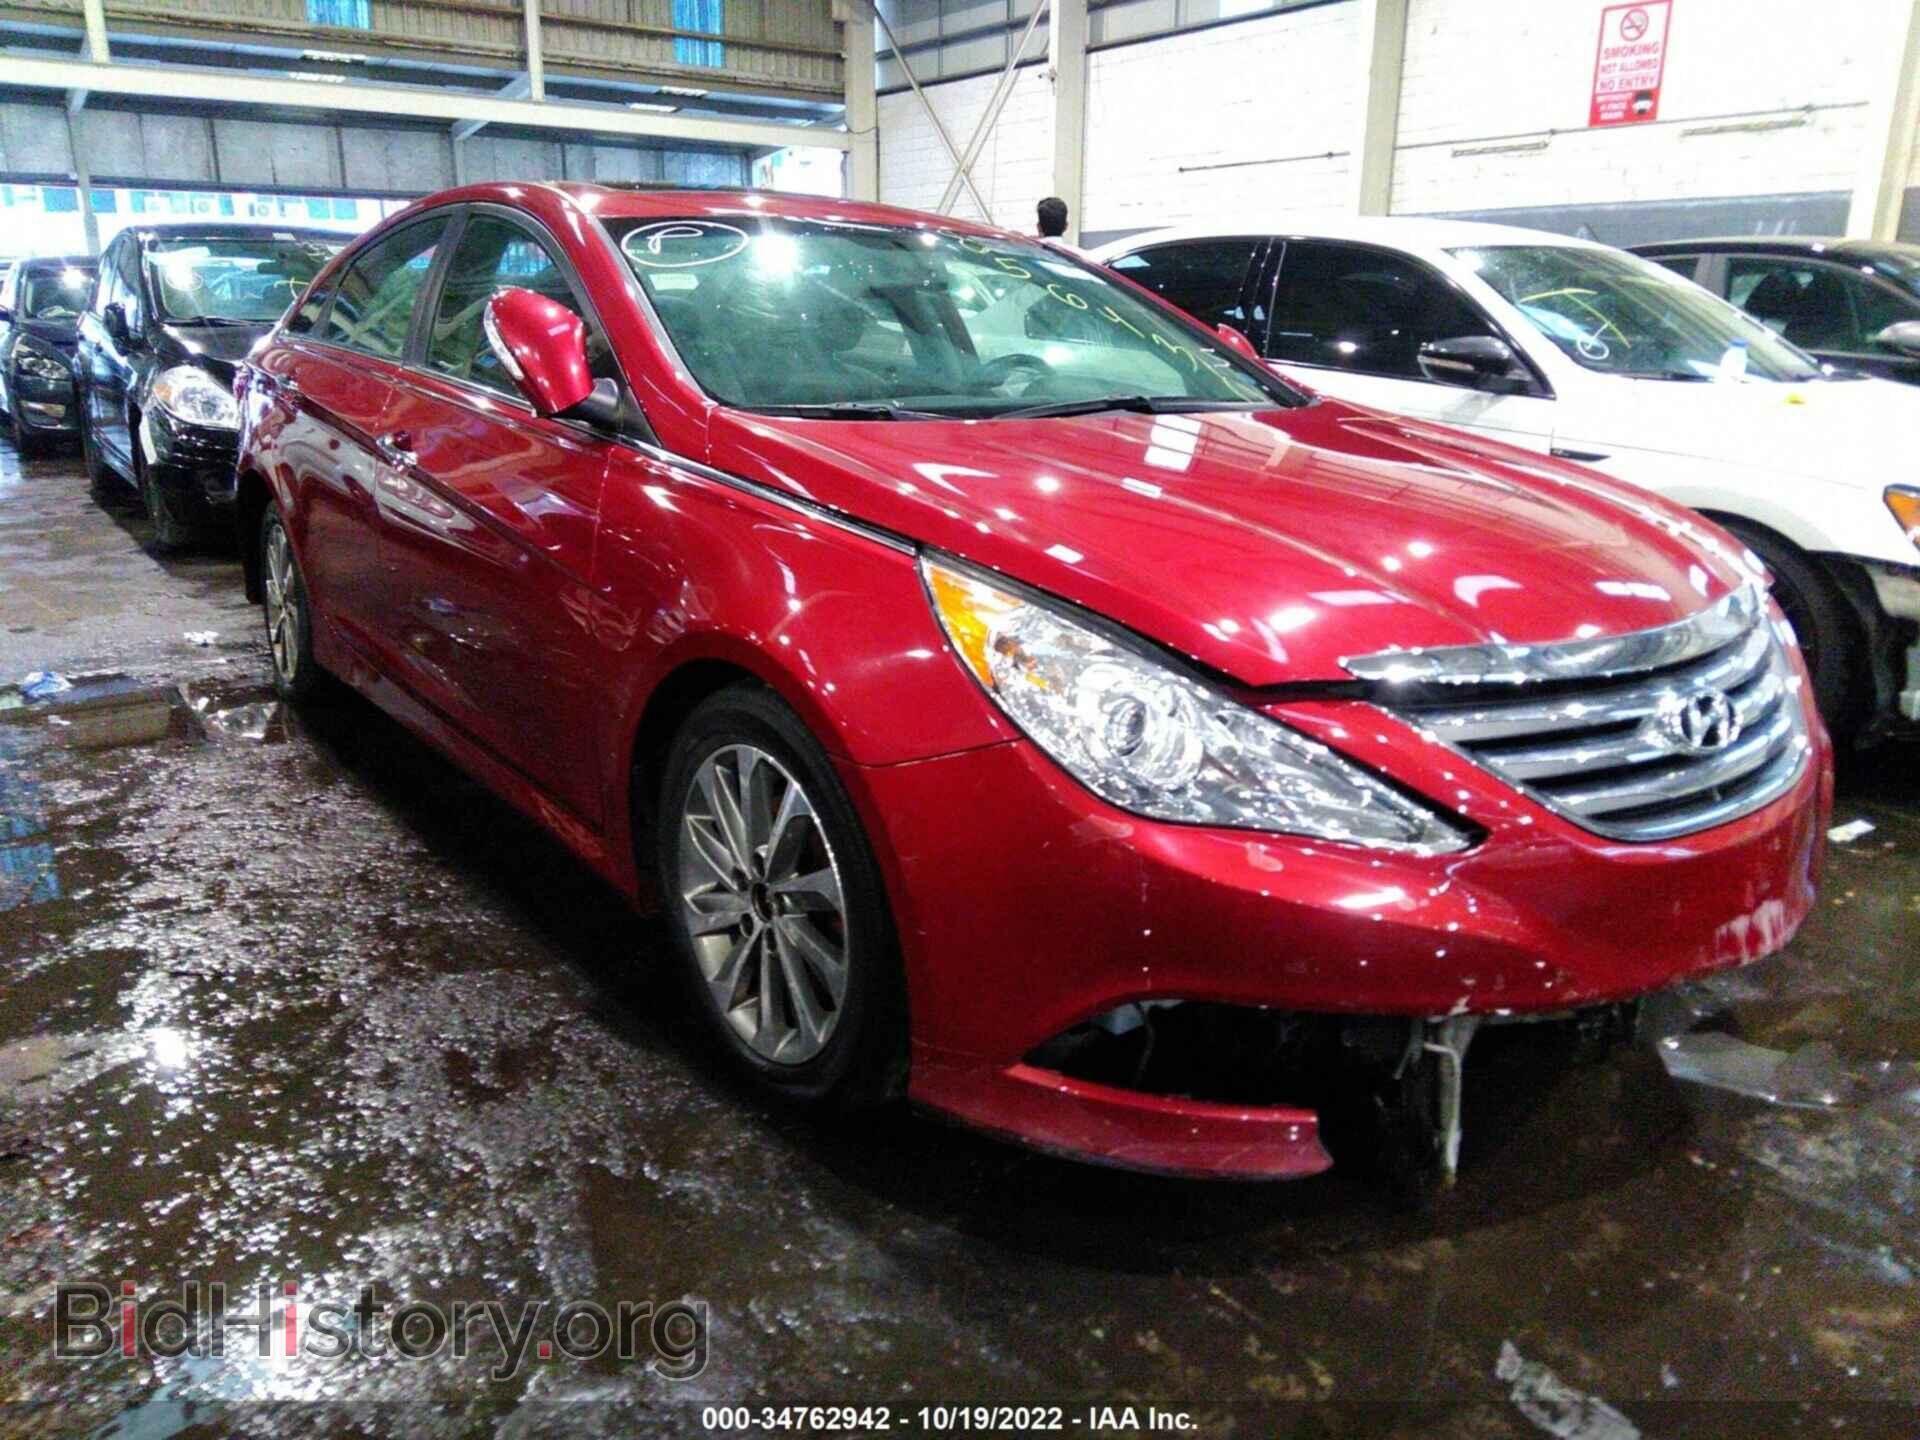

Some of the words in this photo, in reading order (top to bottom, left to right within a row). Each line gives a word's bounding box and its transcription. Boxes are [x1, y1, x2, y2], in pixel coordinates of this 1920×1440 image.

[1603, 42, 1660, 60] SMOKING
[1600, 63, 1617, 74] NOT
[1619, 58, 1659, 72] ALLOWED
[1600, 80, 1615, 90] NO
[1618, 75, 1656, 90] ENTRY
